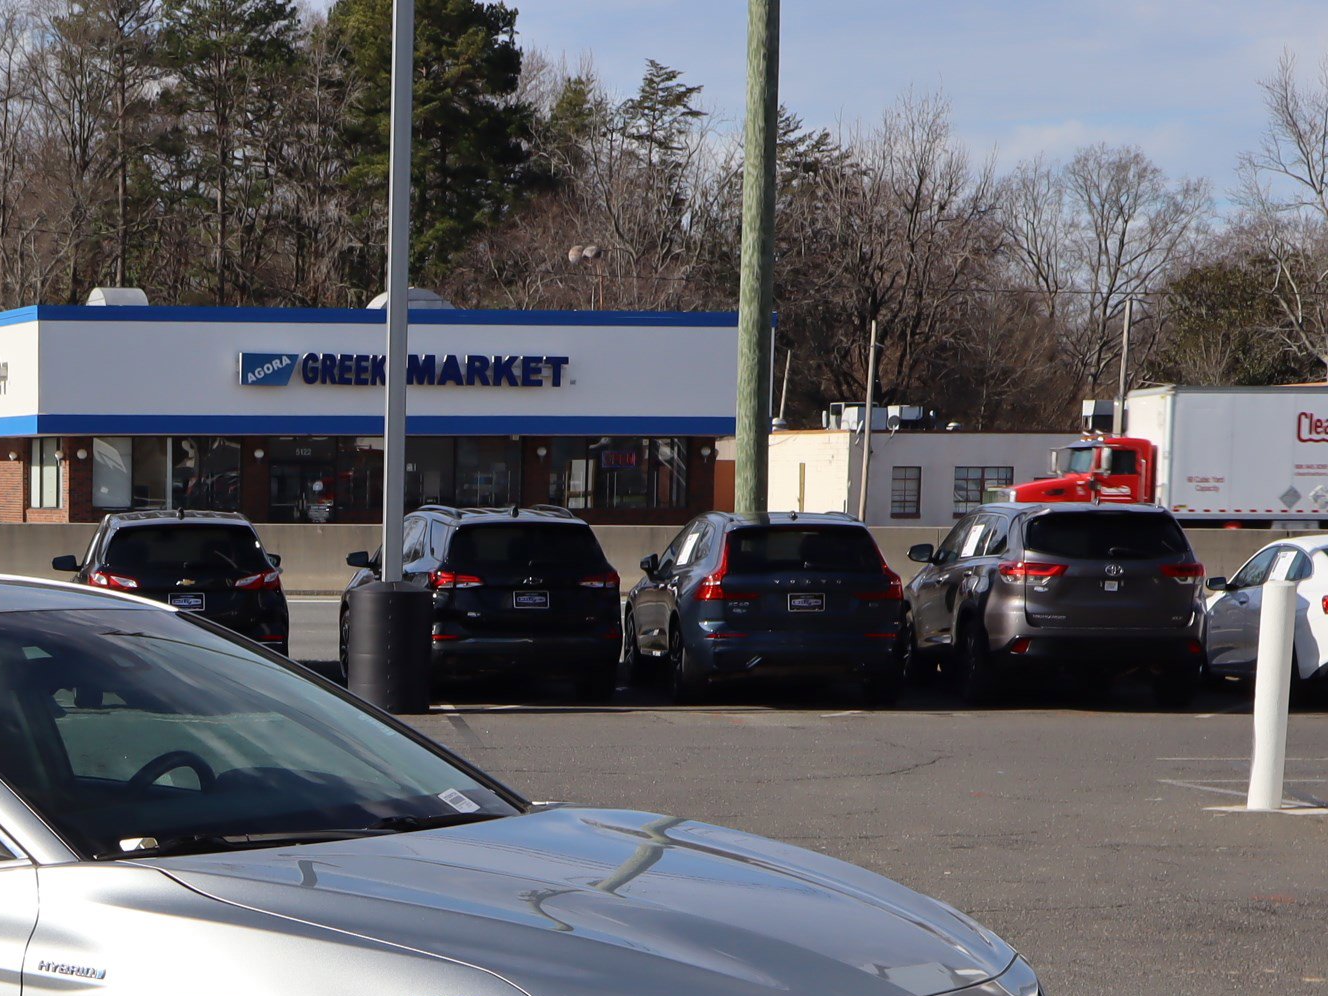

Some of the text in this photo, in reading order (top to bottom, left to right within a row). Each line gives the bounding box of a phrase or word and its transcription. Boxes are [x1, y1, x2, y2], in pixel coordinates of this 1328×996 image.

[246, 352, 570, 388] AGORA GREEK MARKET
[295, 447, 312, 457] 5122
[38, 960, 107, 980] HYBRID
